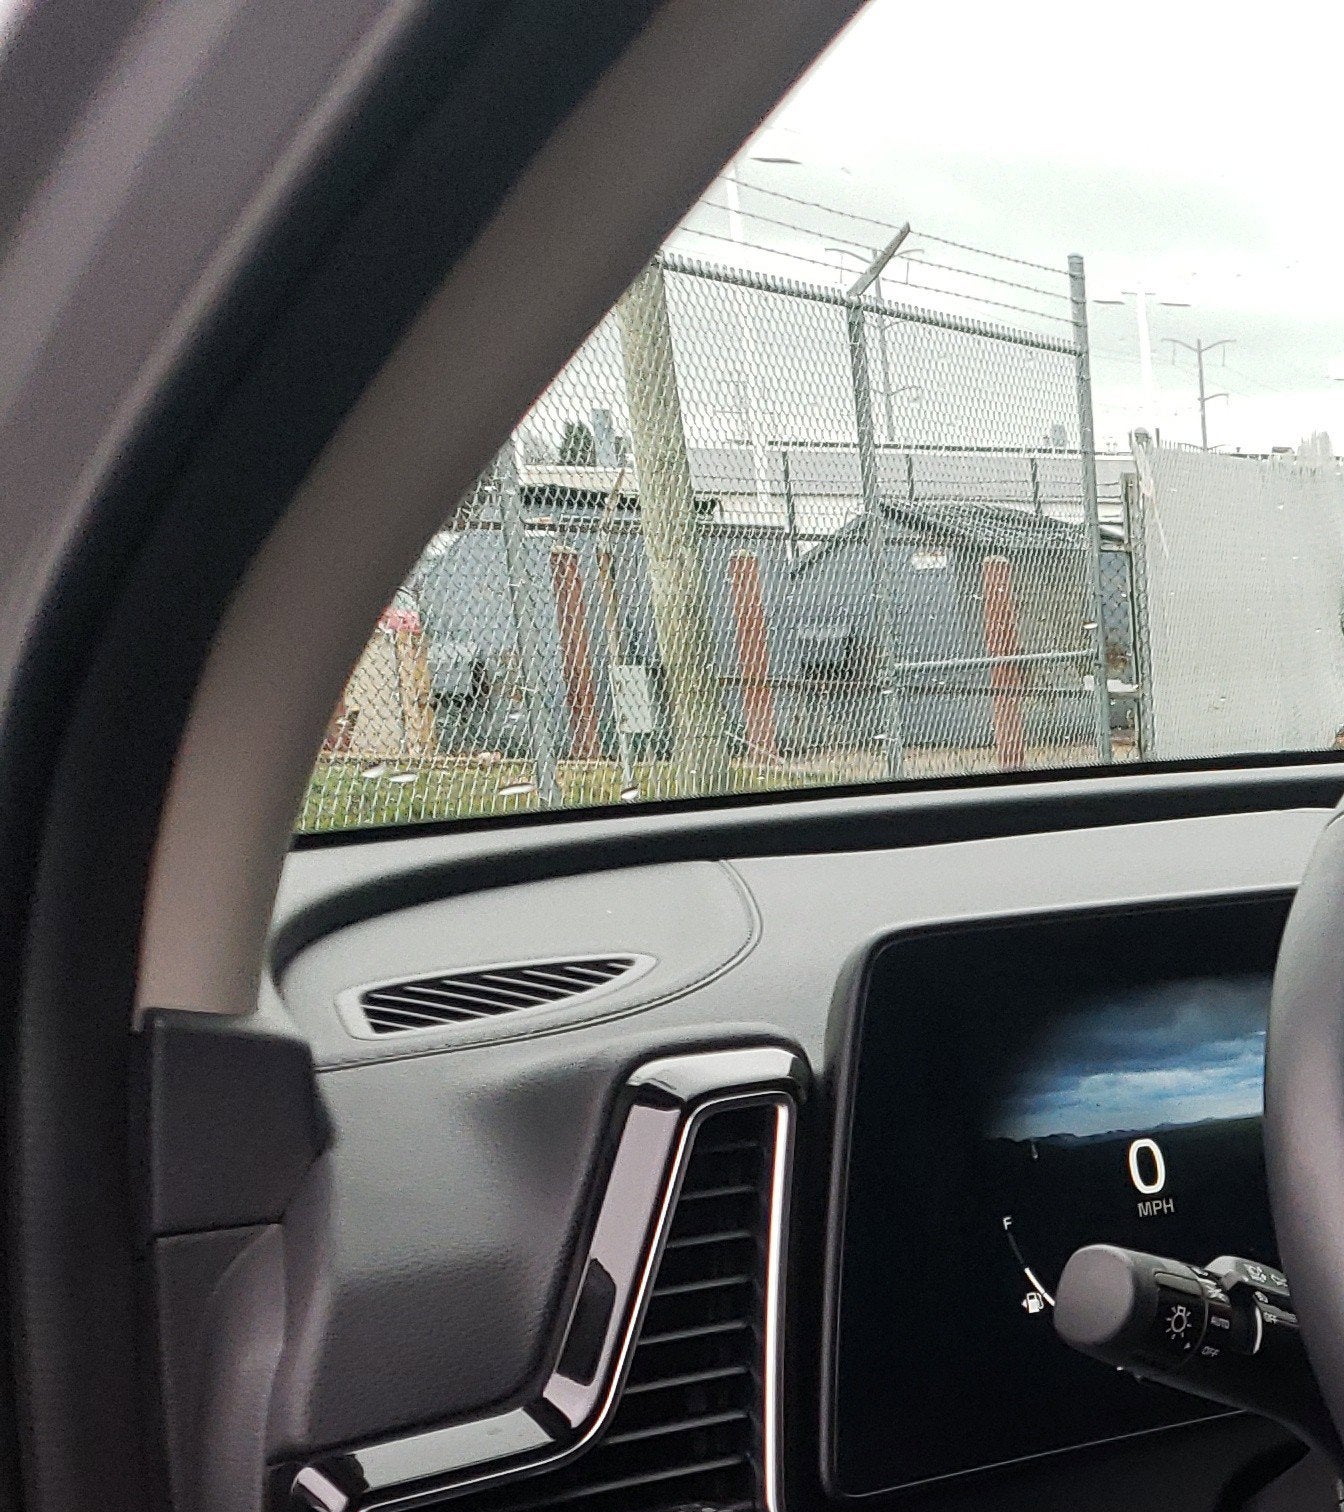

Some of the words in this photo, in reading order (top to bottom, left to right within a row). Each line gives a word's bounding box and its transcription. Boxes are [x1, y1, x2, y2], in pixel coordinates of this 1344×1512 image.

[1128, 1138, 1166, 1195] 0
[1137, 1198, 1175, 1218] MPH
[1002, 1216, 1012, 1230] F
